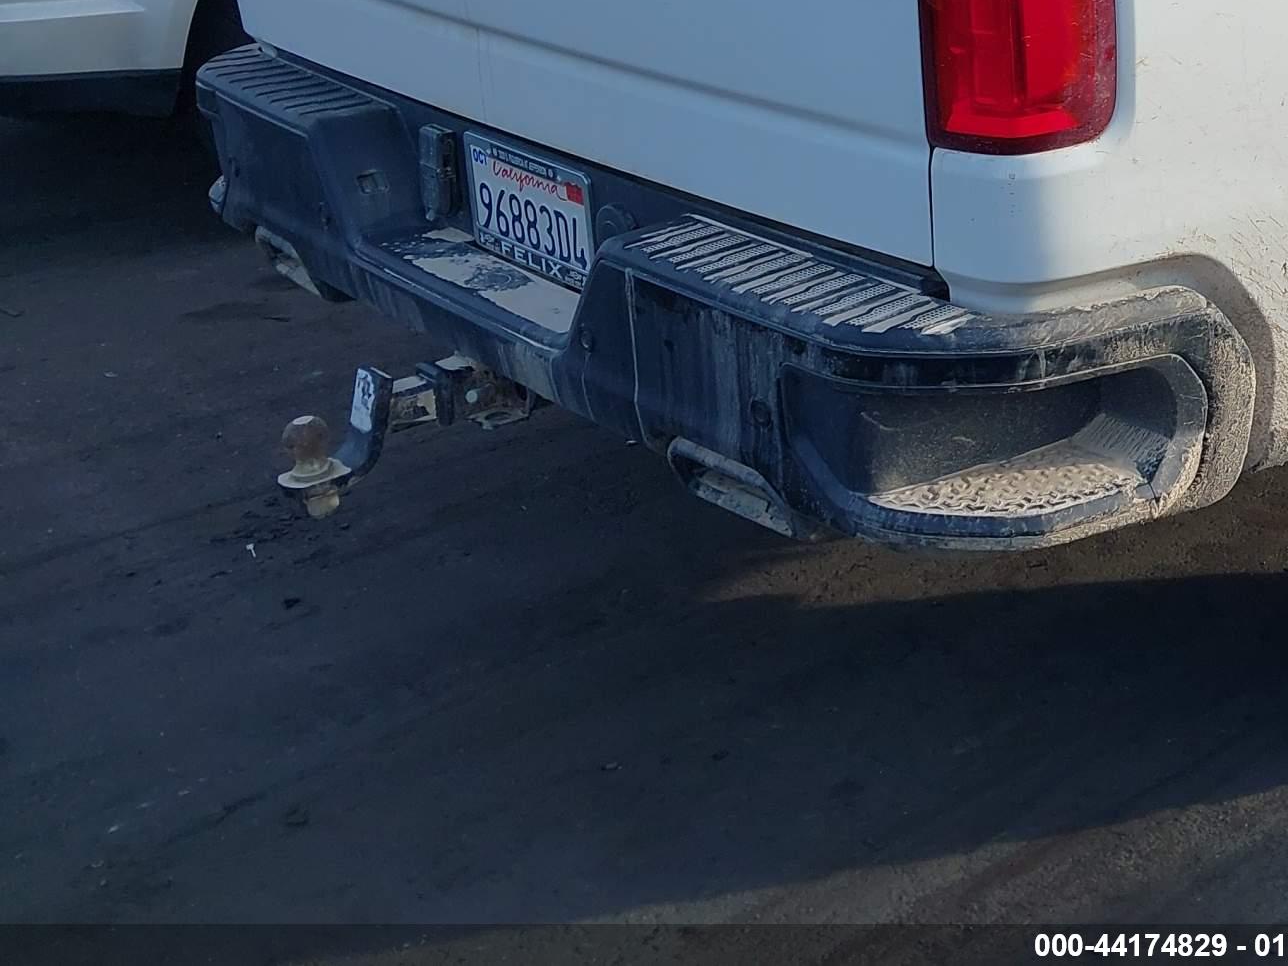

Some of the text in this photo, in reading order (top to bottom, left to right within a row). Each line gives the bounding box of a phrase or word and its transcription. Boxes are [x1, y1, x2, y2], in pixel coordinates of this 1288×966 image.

[472, 148, 487, 165] OCT
[492, 160, 567, 201] California
[501, 241, 563, 280] FELIX
